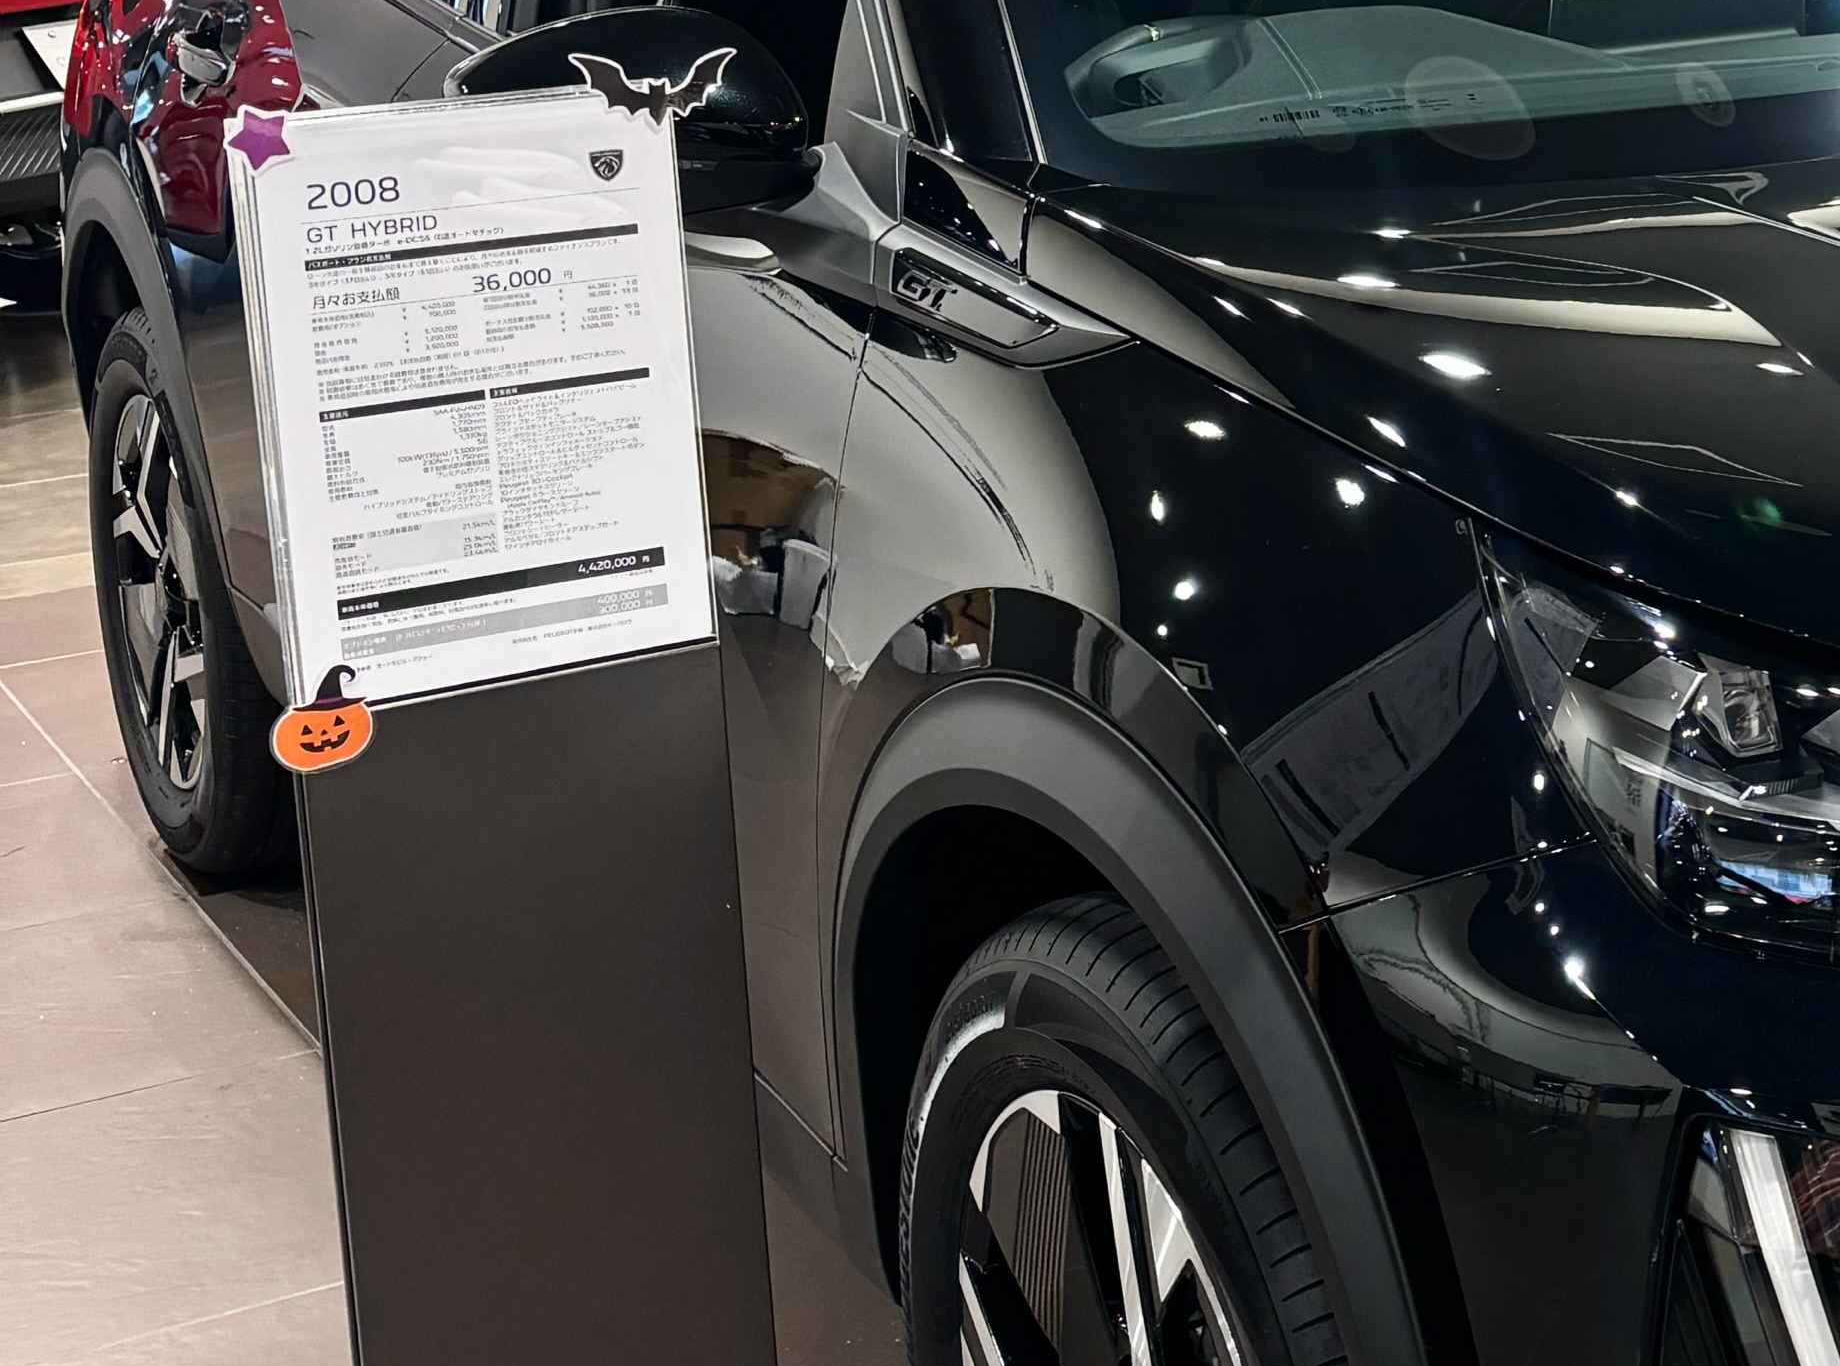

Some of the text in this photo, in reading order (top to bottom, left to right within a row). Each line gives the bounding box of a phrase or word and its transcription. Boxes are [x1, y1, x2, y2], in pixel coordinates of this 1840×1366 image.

[307, 176, 400, 210] 2008
[307, 215, 438, 244] GT HYBRID
[311, 284, 400, 312] 月々お支払額
[472, 267, 552, 293] 36,000
[563, 269, 574, 280] 円
[897, 270, 958, 311] GT
[577, 554, 637, 574] 4,420,000
